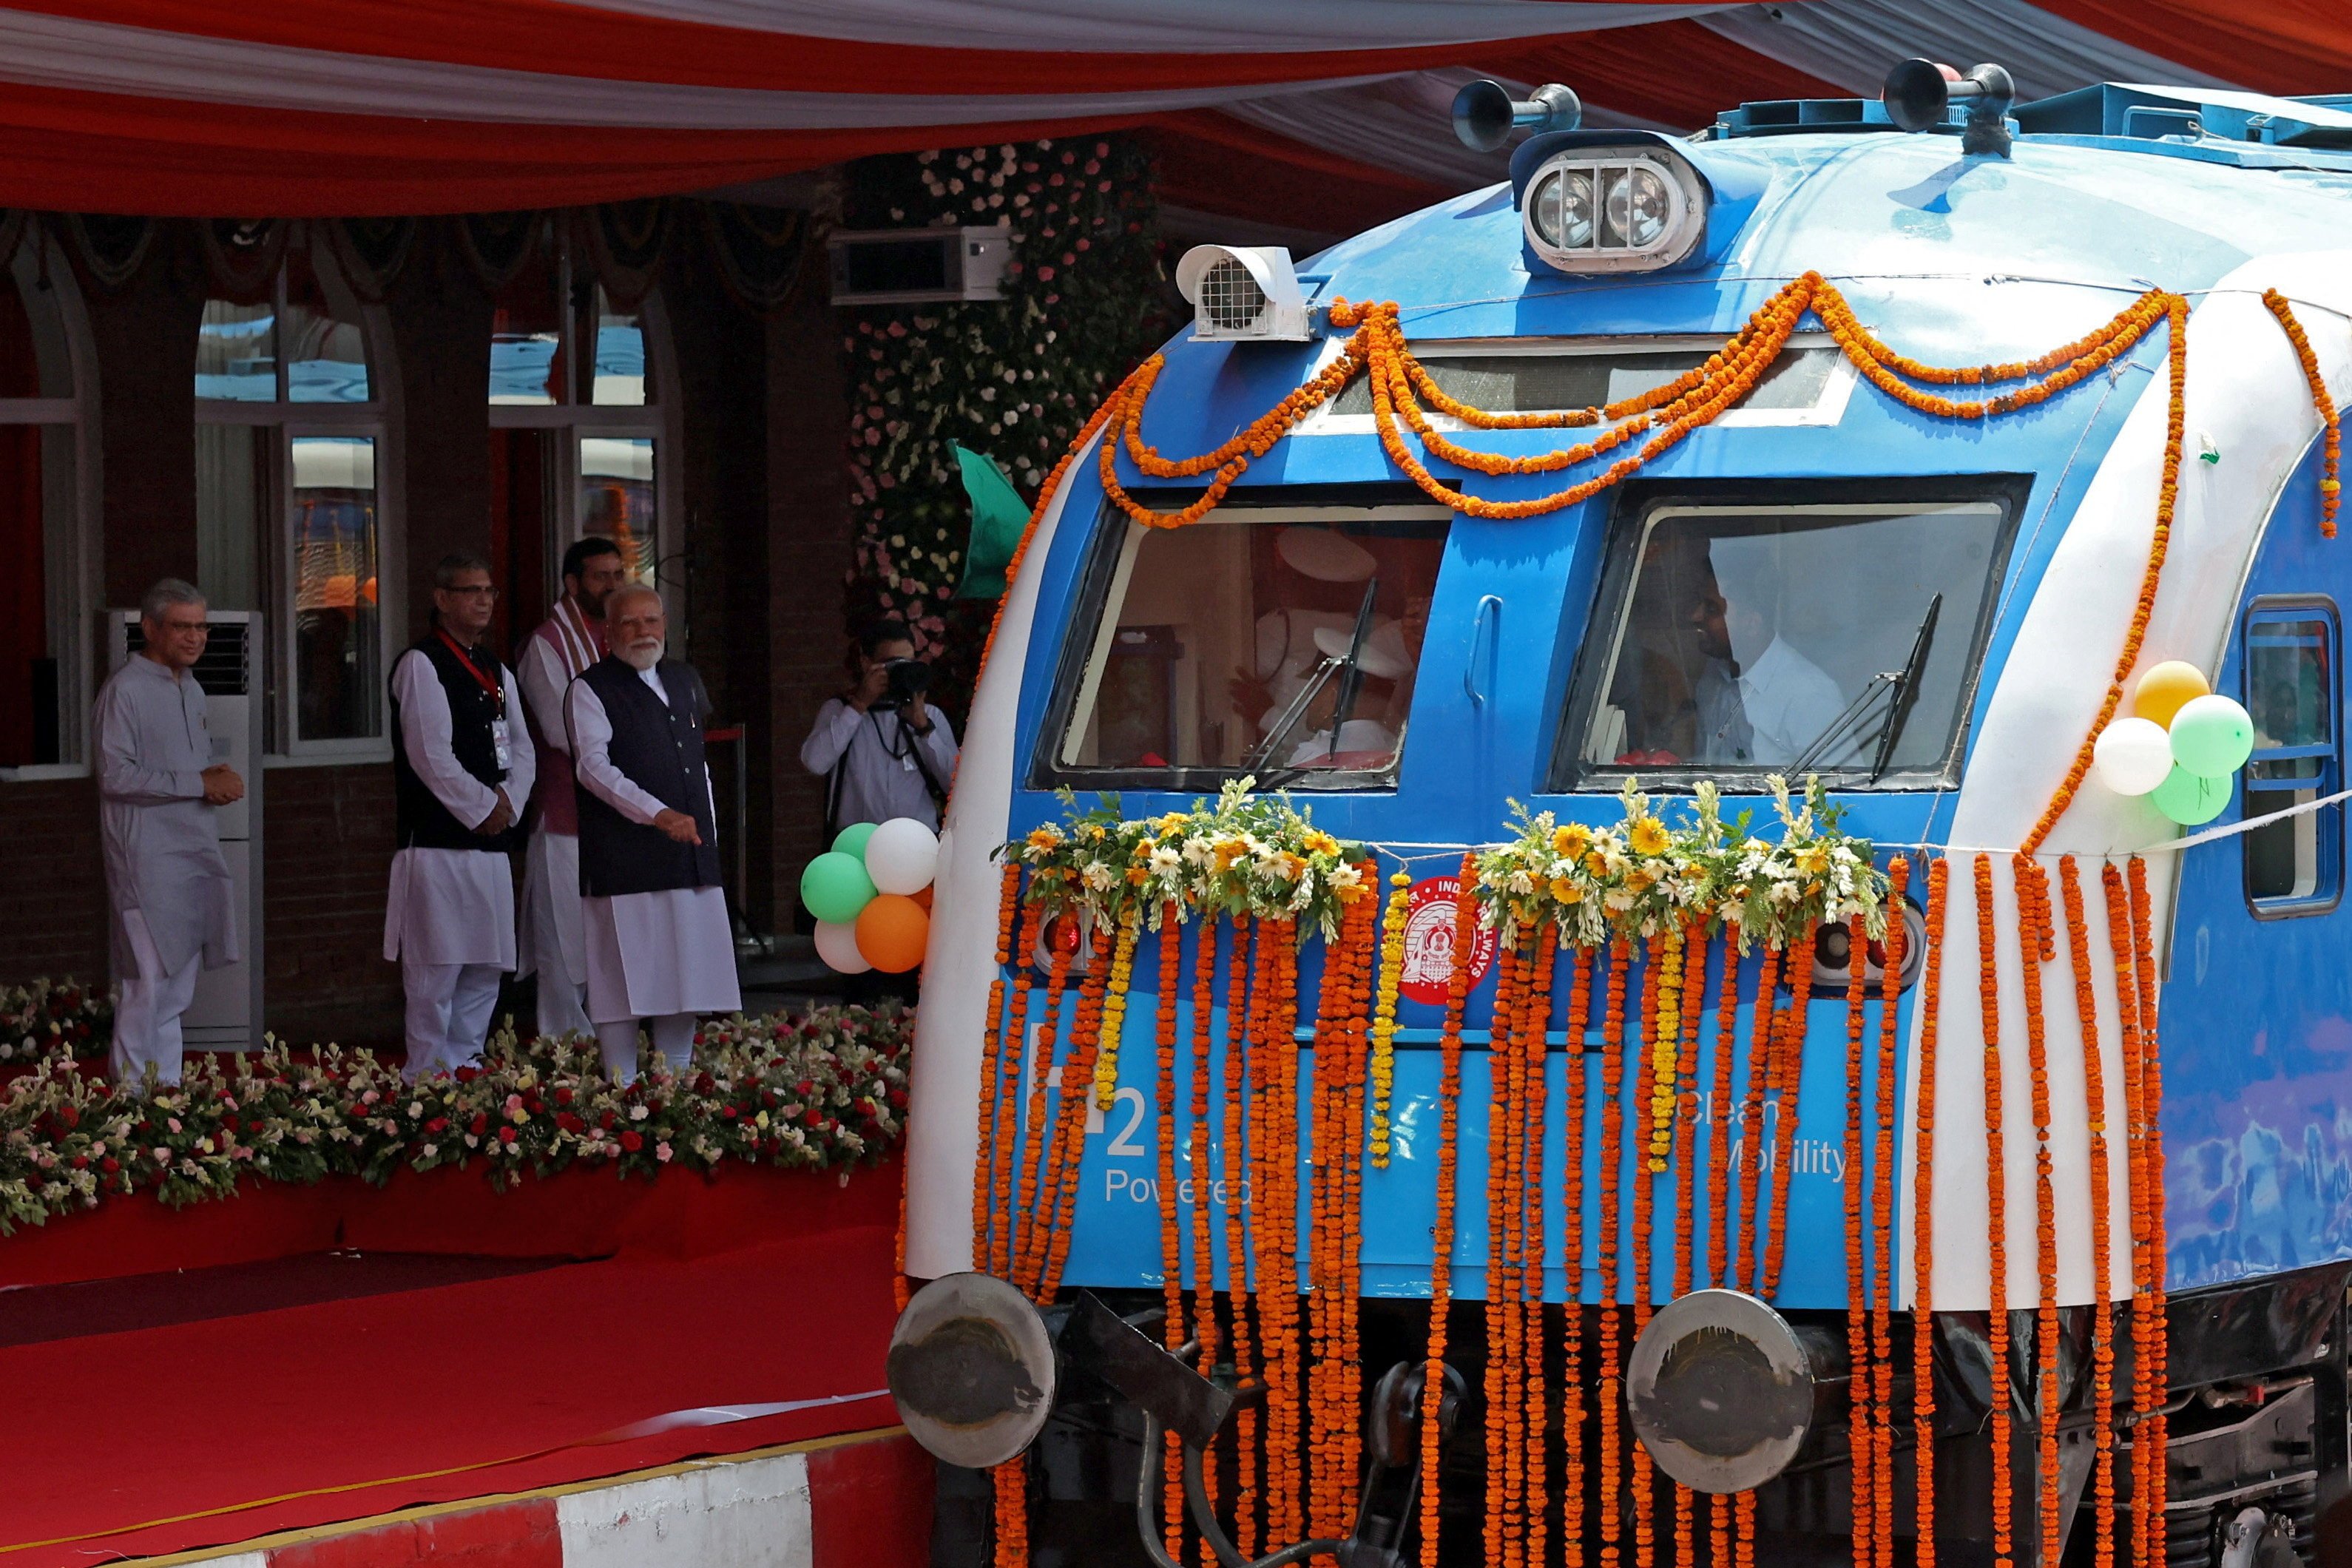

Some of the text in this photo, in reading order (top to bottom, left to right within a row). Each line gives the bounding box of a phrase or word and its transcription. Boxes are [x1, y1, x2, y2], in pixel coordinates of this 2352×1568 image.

[1438, 880, 1493, 978] IND RLWAYS
[1106, 1169, 1253, 1205] Poeed
